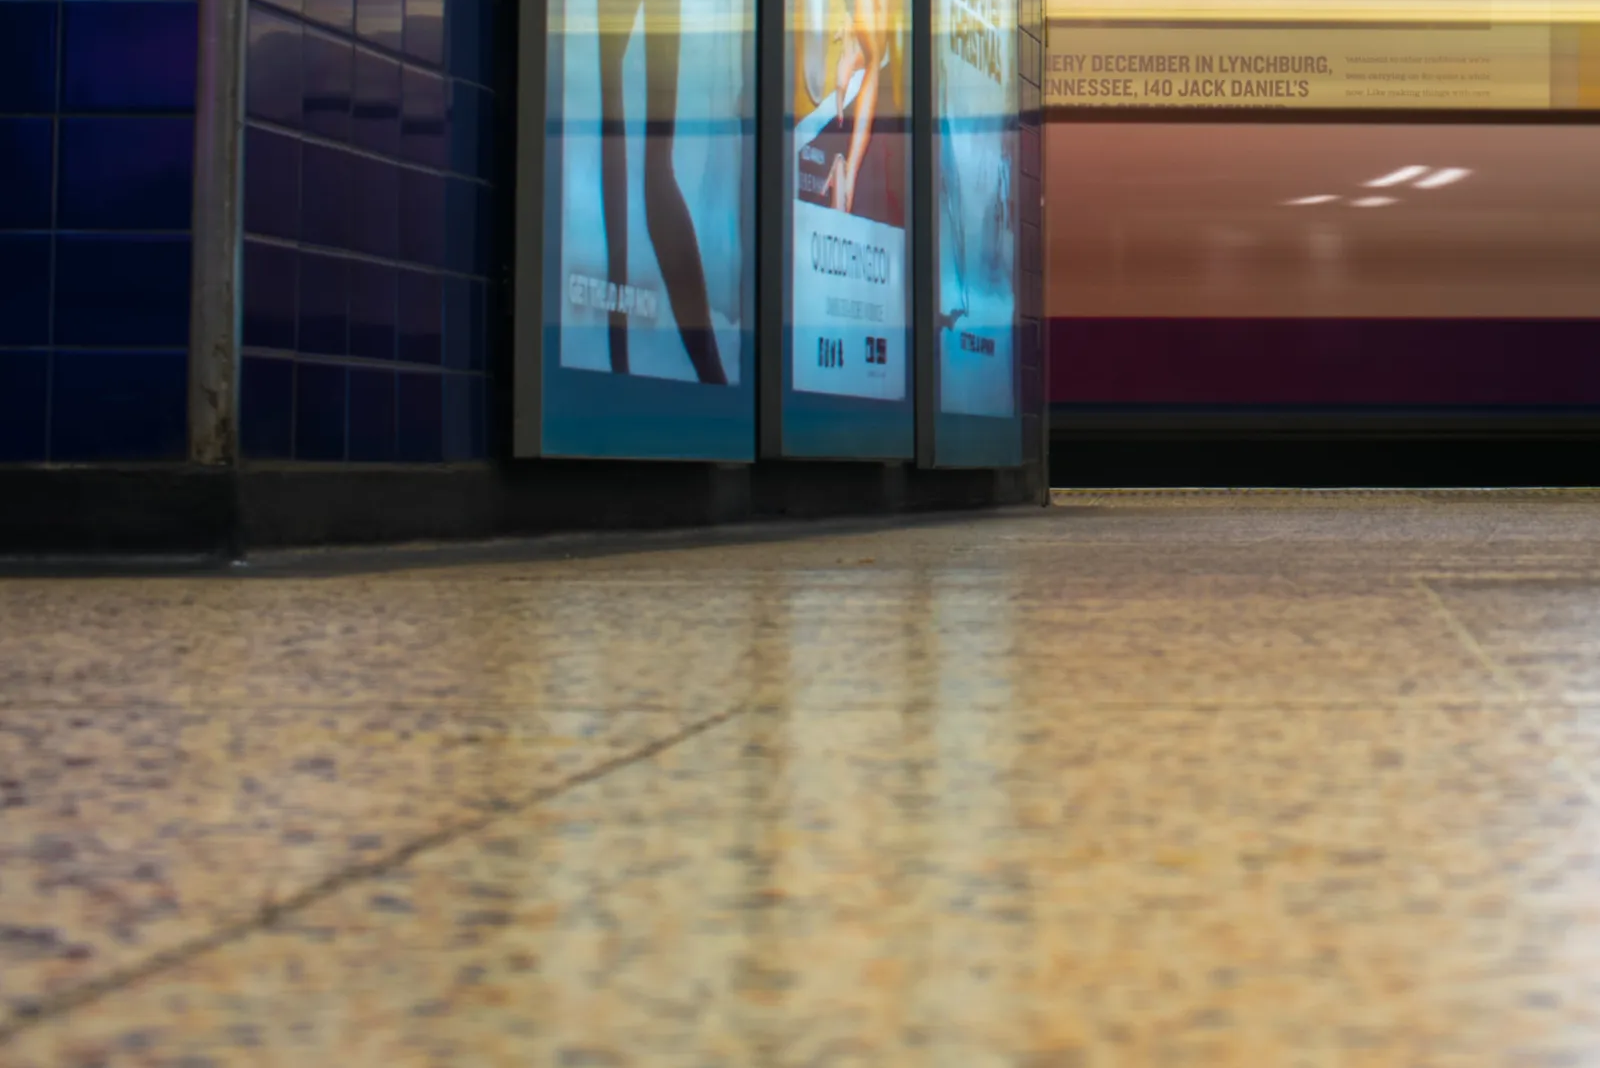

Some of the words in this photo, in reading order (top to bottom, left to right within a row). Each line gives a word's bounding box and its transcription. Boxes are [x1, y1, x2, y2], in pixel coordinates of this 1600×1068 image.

[1091, 54, 1190, 73] DECEMBER
[1195, 55, 1214, 73] IN
[1218, 55, 1333, 76] LYNCHBURG,
[1143, 79, 1173, 97] 140
[1178, 79, 1226, 98] JACK
[1231, 80, 1309, 98] DANIEL'S
